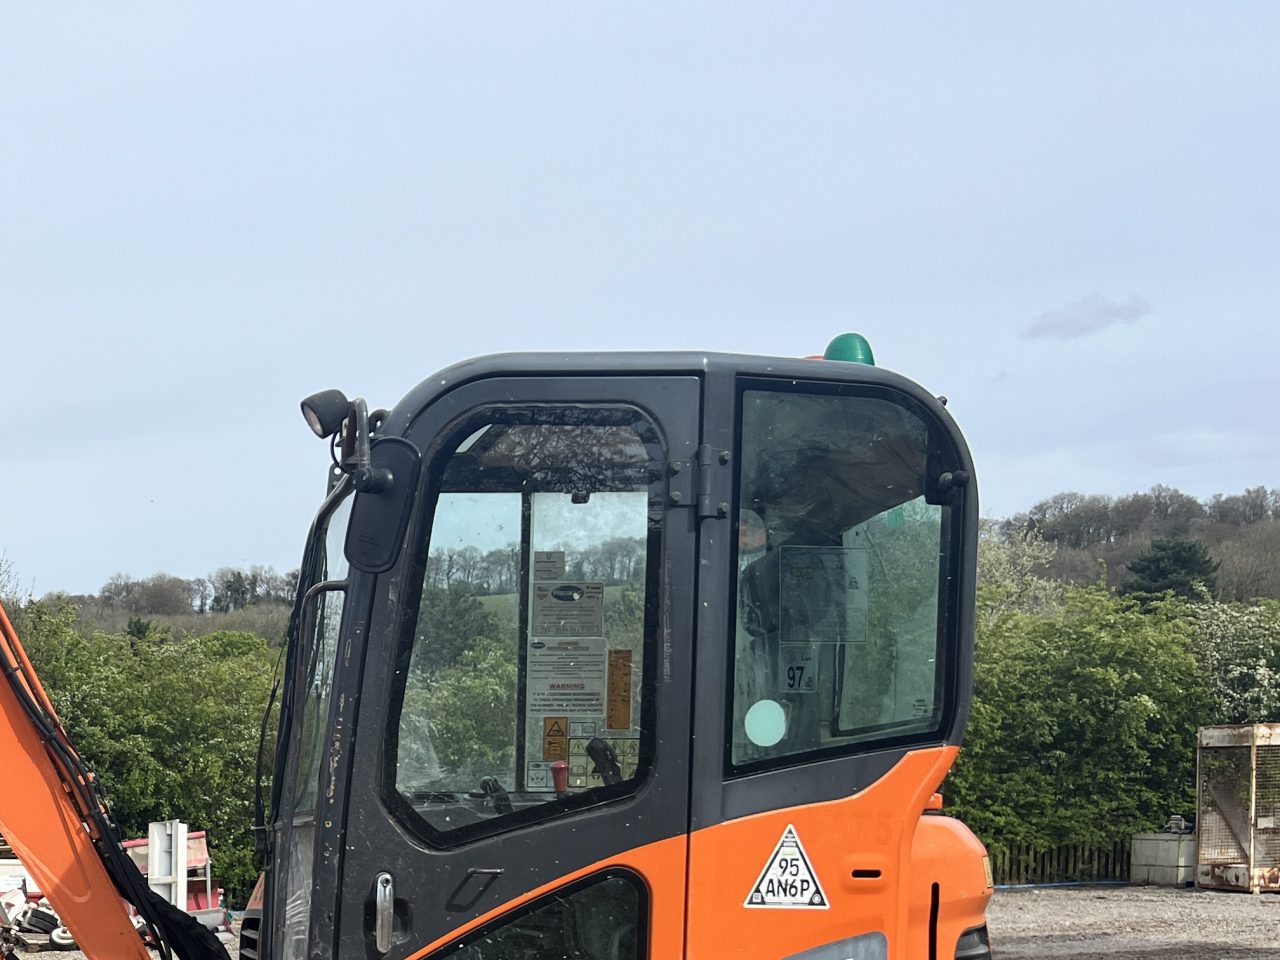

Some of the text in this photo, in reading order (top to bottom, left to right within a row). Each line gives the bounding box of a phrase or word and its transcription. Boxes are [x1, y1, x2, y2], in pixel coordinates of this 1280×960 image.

[787, 665, 805, 688] 97
[779, 857, 800, 877] 95
[765, 878, 811, 898] AN6P
